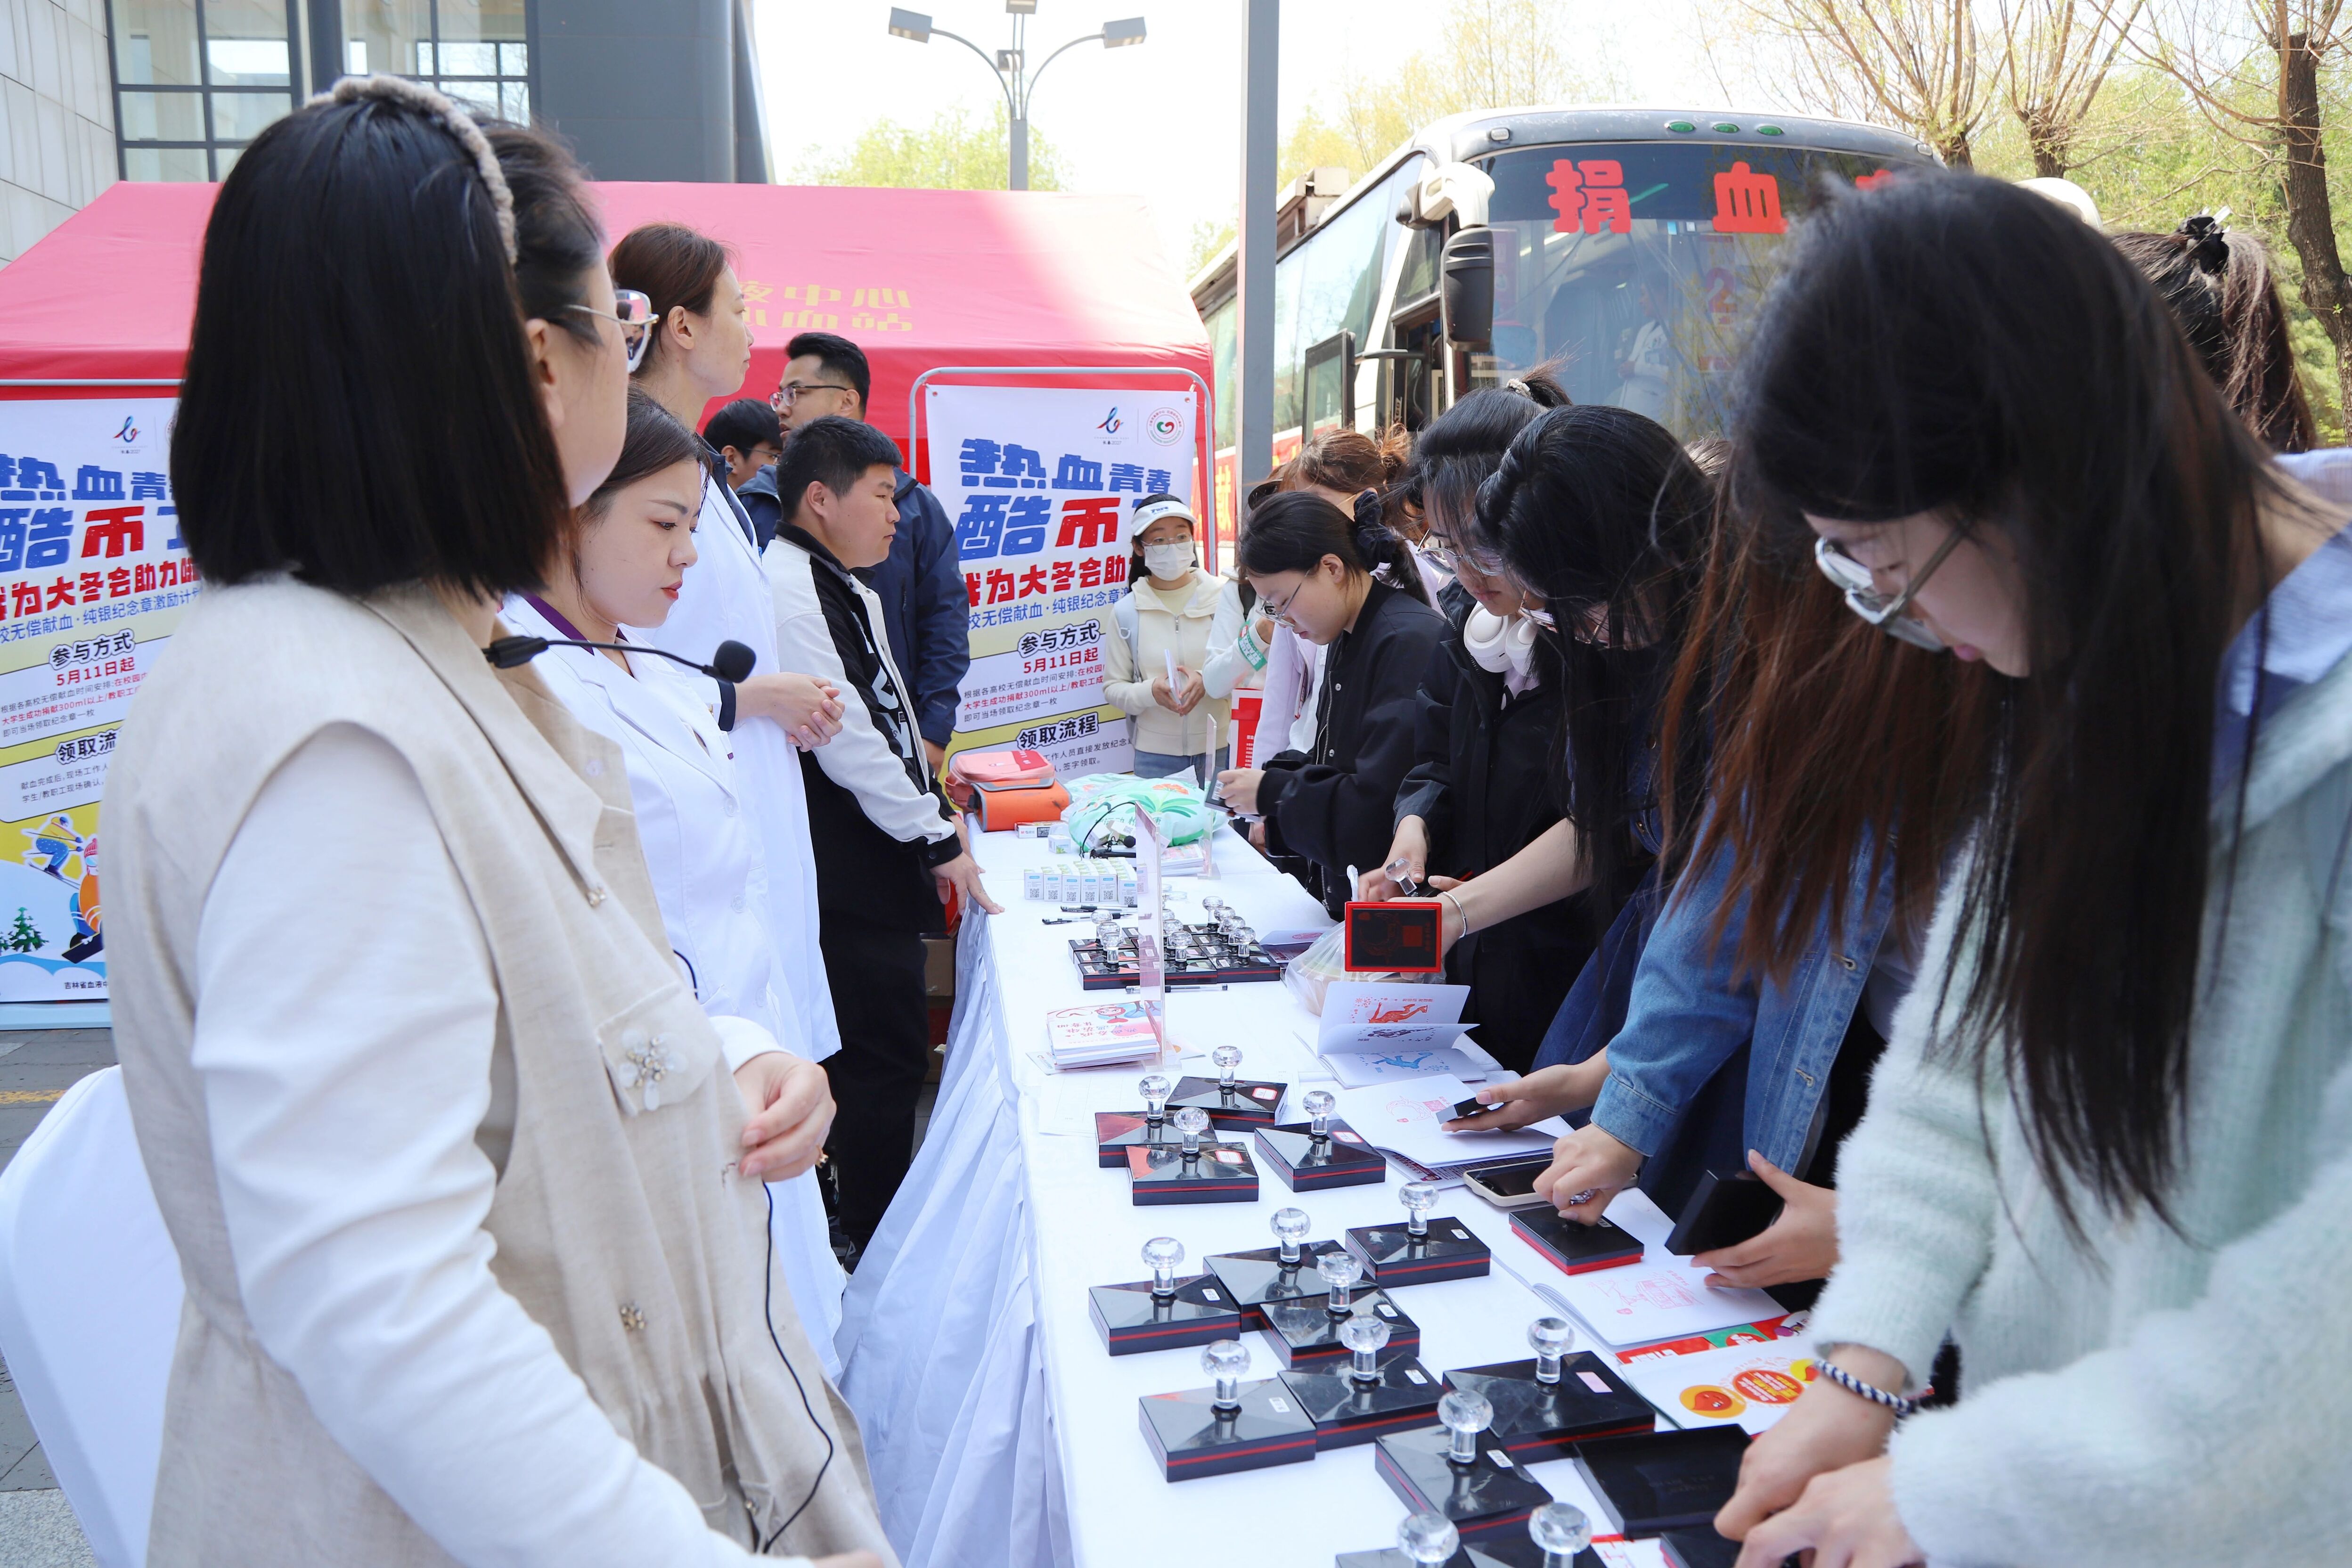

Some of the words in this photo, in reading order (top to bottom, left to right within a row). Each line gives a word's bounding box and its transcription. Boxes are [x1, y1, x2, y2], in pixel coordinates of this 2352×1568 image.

[1545, 159, 1893, 234] 捐血
[0, 453, 173, 501] 热血青
[959, 438, 1171, 493] 热血青春
[954, 495, 1143, 561] 酷币
[52, 632, 131, 667] 参与方式
[1021, 622, 1096, 654] 参与方式
[56, 657, 135, 686] 5月11日起
[1023, 647, 1098, 674] 5月11日起
[964, 664, 1105, 698] 根据各高校无偿献血时间安排:在校园
[3, 709, 95, 738] 即可当场领取纪念章一枚
[964, 697, 1057, 722] 即可当场领取纪念章一枚
[1019, 714, 1097, 748] 领取流程
